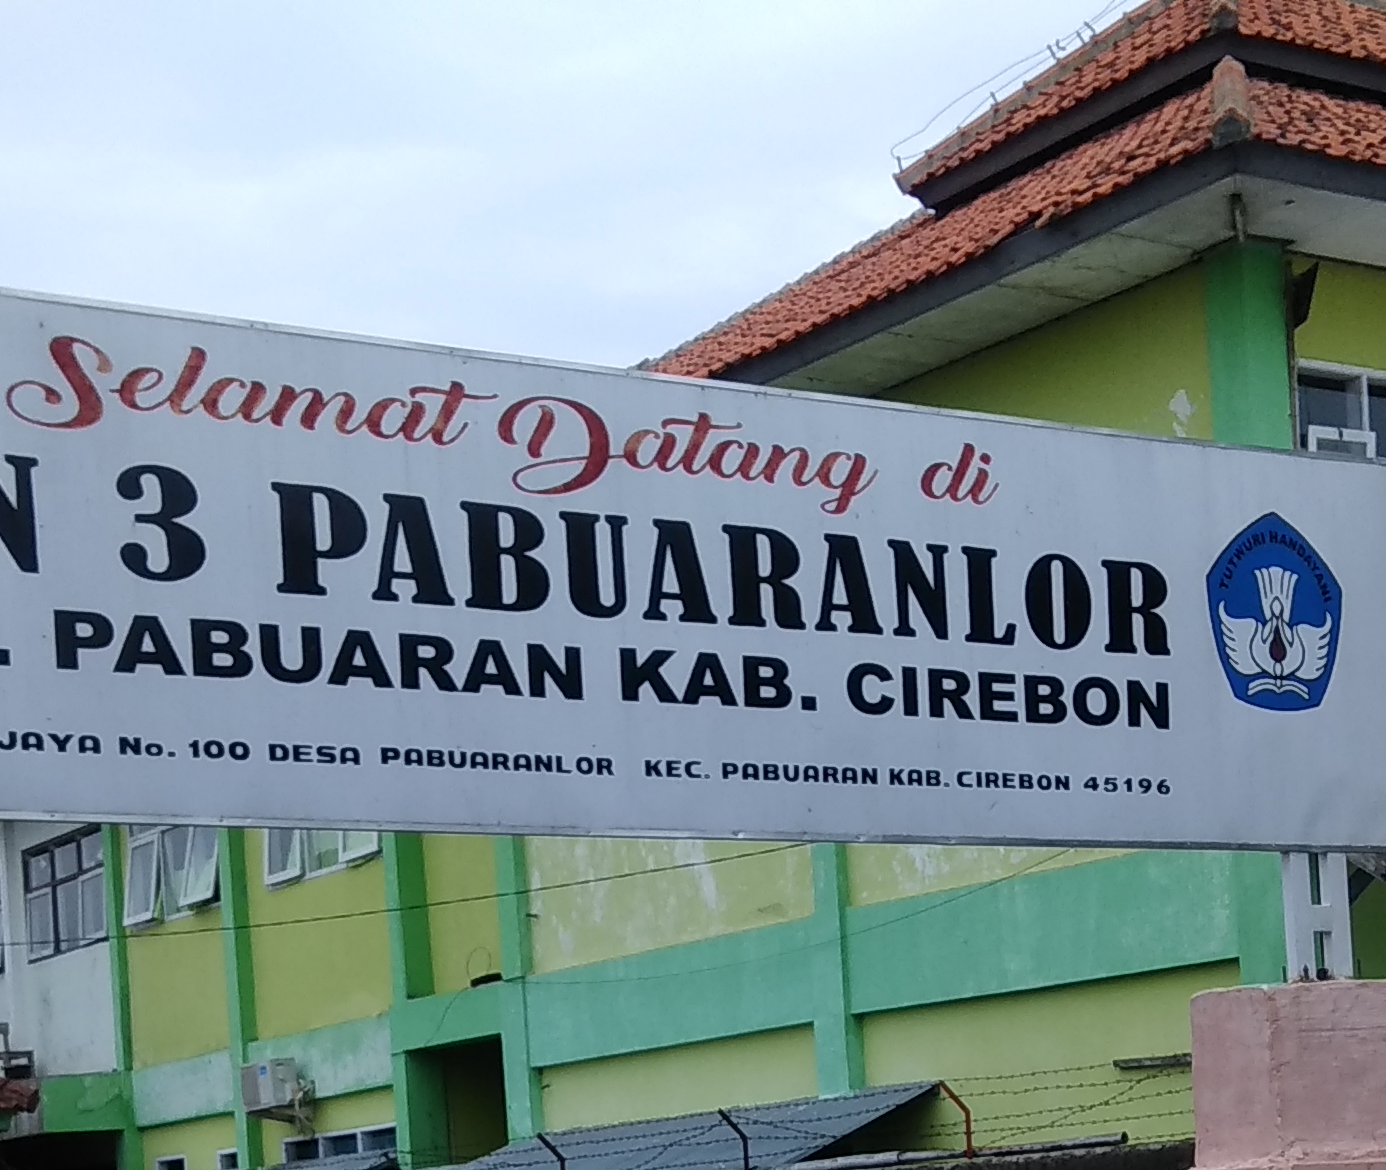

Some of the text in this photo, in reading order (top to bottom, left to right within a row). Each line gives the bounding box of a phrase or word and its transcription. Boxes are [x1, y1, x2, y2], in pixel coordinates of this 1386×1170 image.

[5, 336, 999, 516] Selamat Datang di
[116, 464, 207, 582] 3
[270, 482, 1171, 657] PABUARANLOR
[1268, 530, 1332, 603] HANDAYANI
[53, 609, 585, 701] PABUARAN
[618, 647, 818, 712] KAB.
[846, 662, 1170, 731] CIREBON
[118, 736, 176, 758] No.
[188, 739, 251, 761] 100
[268, 743, 361, 766] DESA
[380, 746, 615, 776] PABUARANLOR
[644, 759, 711, 780] KEC.
[721, 762, 879, 785] PABUARAN
[888, 768, 951, 789] KAB.
[956, 771, 1071, 791] CIREBON
[1083, 776, 1171, 795] 45196
